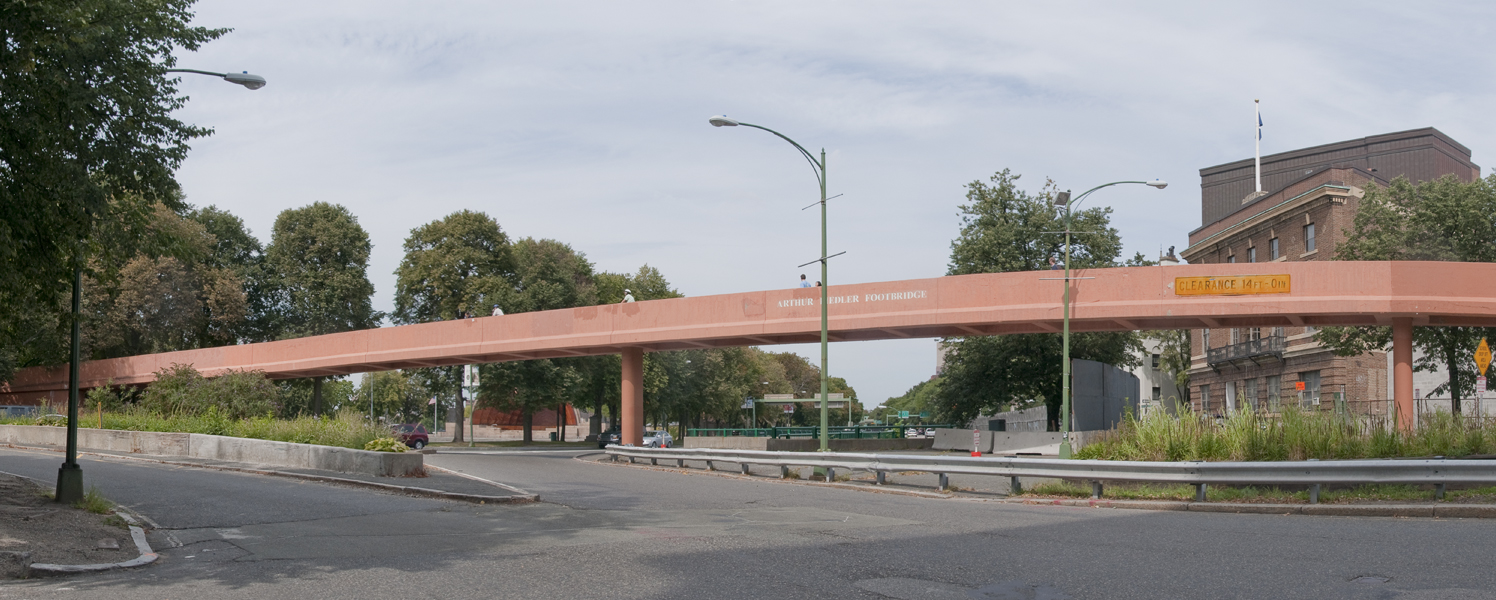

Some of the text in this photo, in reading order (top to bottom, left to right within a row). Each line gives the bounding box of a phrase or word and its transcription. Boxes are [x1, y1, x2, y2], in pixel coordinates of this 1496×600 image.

[1179, 279, 1237, 292] CLEARANCE
[777, 297, 814, 308] ARTHUR
[865, 289, 928, 302] FOOTBRIDGE
